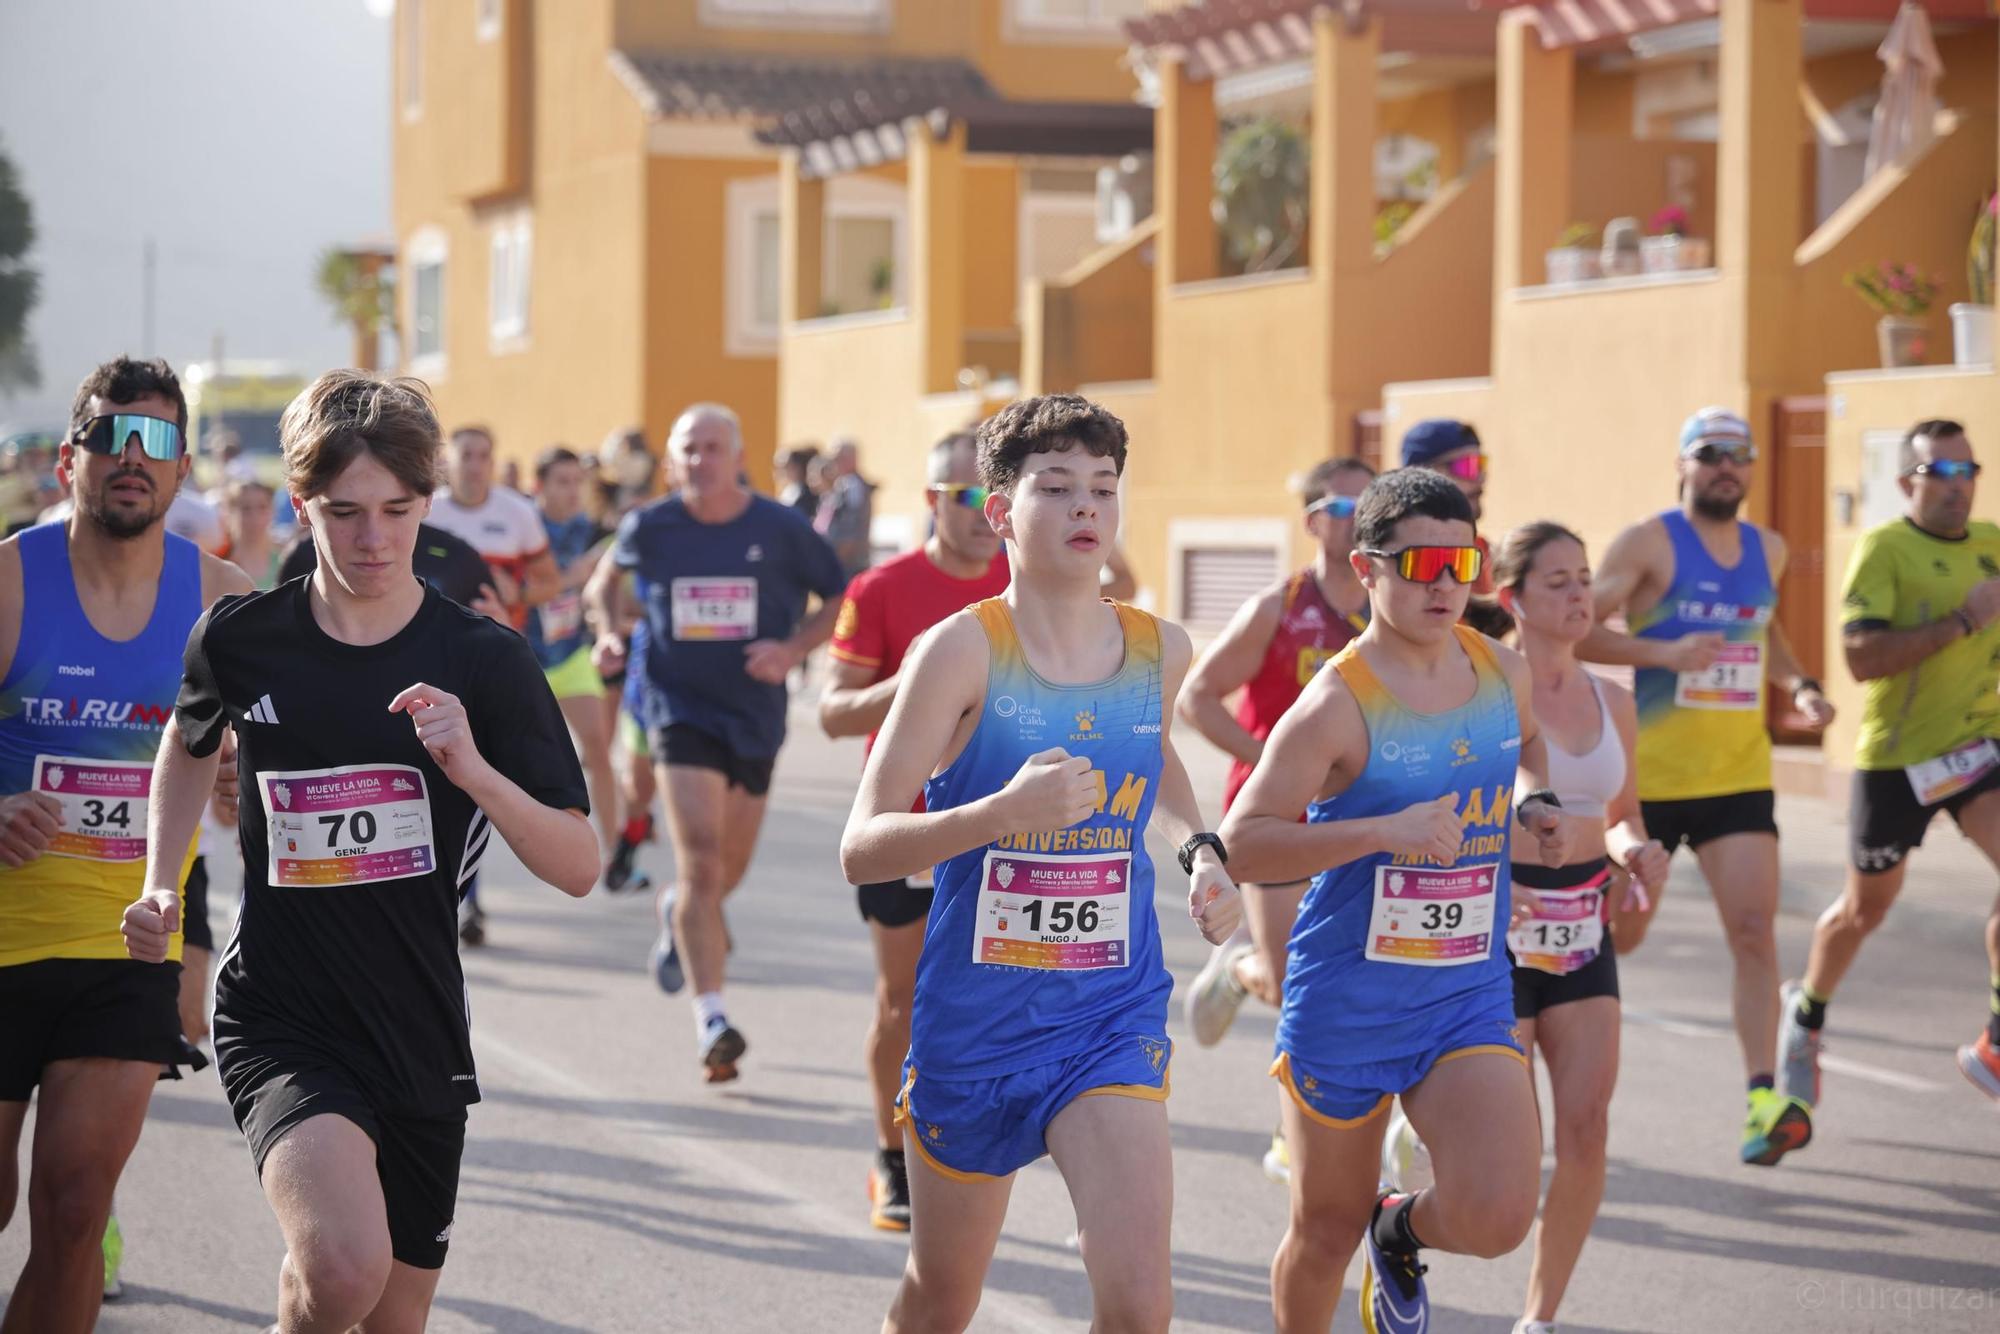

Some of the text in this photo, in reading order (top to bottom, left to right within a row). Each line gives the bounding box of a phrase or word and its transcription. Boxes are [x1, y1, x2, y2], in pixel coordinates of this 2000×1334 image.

[58, 665, 95, 676] mobel
[25, 716, 86, 727] TRIATHLON
[91, 721, 118, 729] TEAM
[122, 723, 151, 731] POZO
[1069, 732, 1104, 741] KELME
[306, 777, 380, 795] MUEVE LA VIDA
[81, 799, 131, 829] 34
[77, 827, 131, 838] CEREZUELA
[318, 810, 377, 848] 70
[335, 846, 368, 857] GENIZ
[1031, 869, 1098, 880] MUEVE LA VIDA
[1022, 899, 1100, 933] 156
[1421, 903, 1463, 930] 39
[1041, 935, 1079, 943] HUGO J
